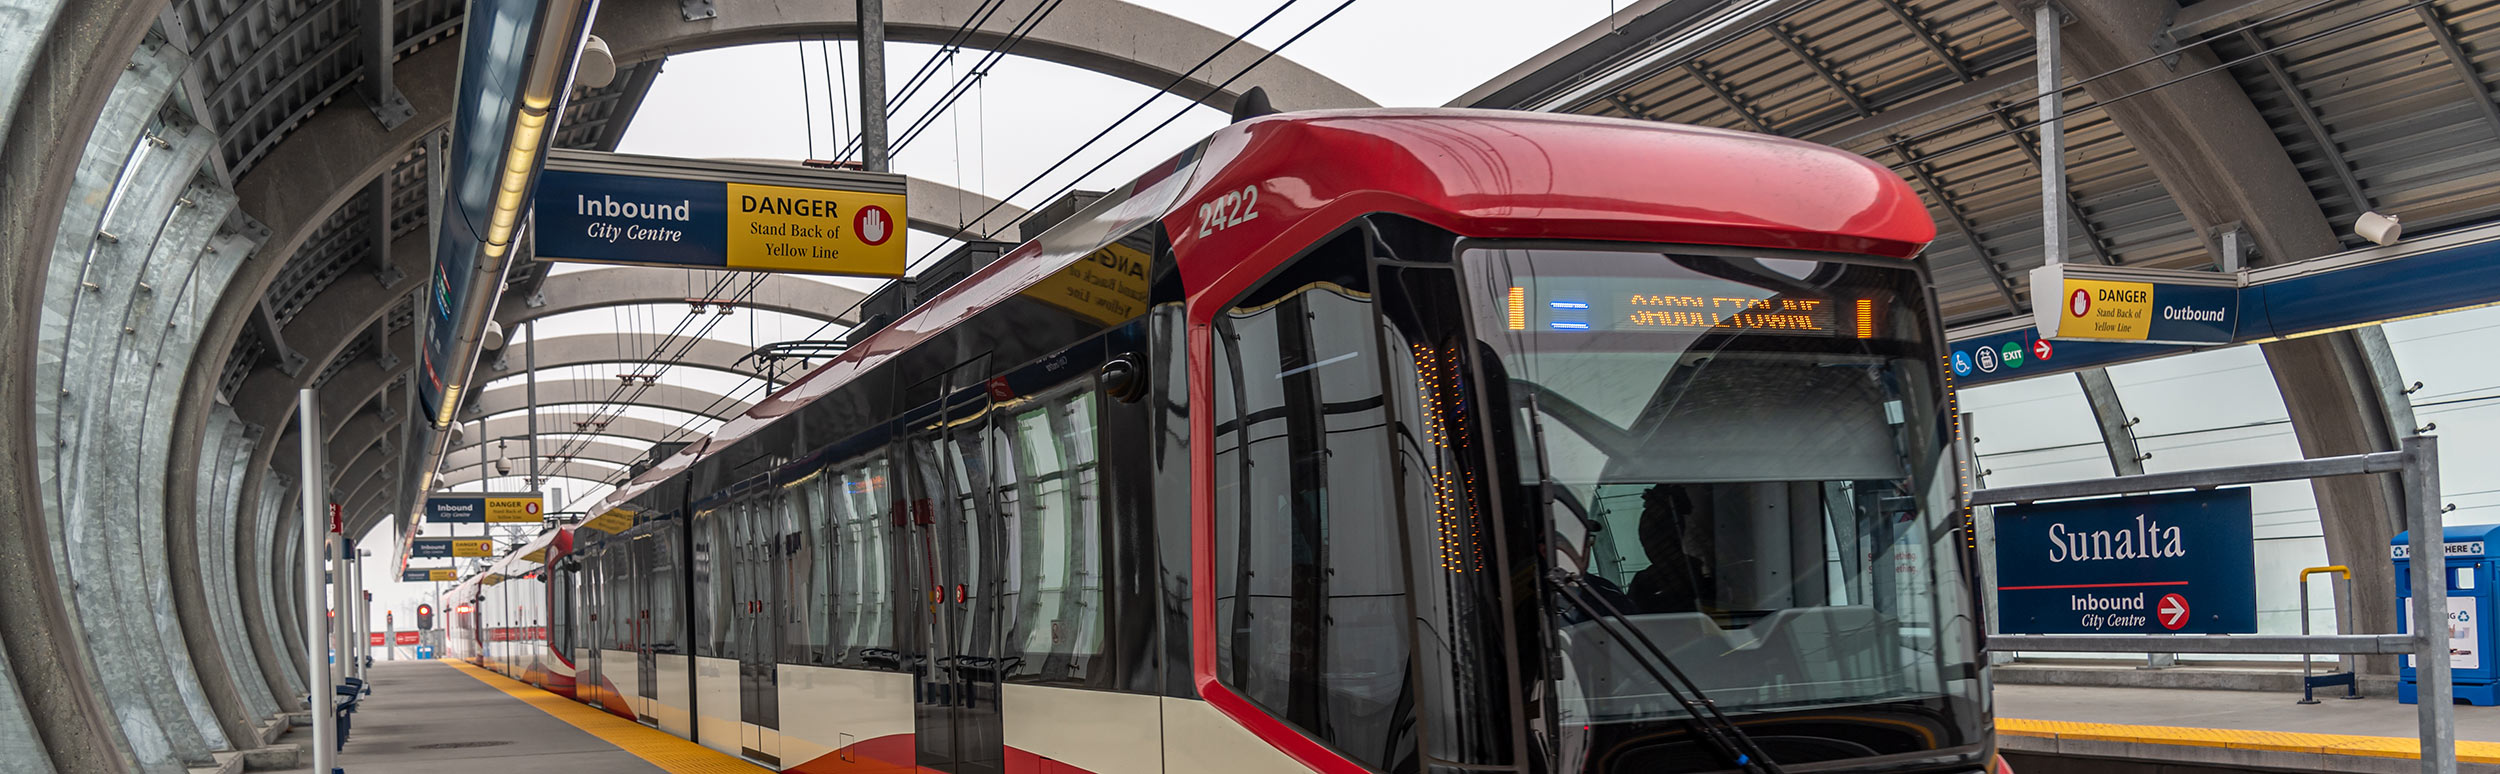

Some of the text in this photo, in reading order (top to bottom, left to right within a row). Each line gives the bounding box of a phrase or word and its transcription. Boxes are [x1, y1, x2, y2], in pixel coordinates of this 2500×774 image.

[578, 194, 690, 222] Inbound
[742, 195, 838, 218] DANGER
[1199, 184, 1259, 239] 2422
[587, 222, 682, 243] City Centre
[750, 222, 840, 239] Stand Back of
[766, 243, 839, 259] Yellow Line
[2099, 289, 2147, 303] DANGER
[2096, 307, 2142, 319] Stand Back of
[2163, 304, 2225, 322] Outbound
[2094, 321, 2132, 332] Yellow Line
[2003, 349, 2022, 361] EXIT
[437, 504, 473, 512] Inbound
[2049, 514, 2186, 562] Sunalta
[2445, 545, 2468, 554] HERE
[2072, 592, 2144, 611] Inbound
[2081, 613, 2146, 630] City Centre
